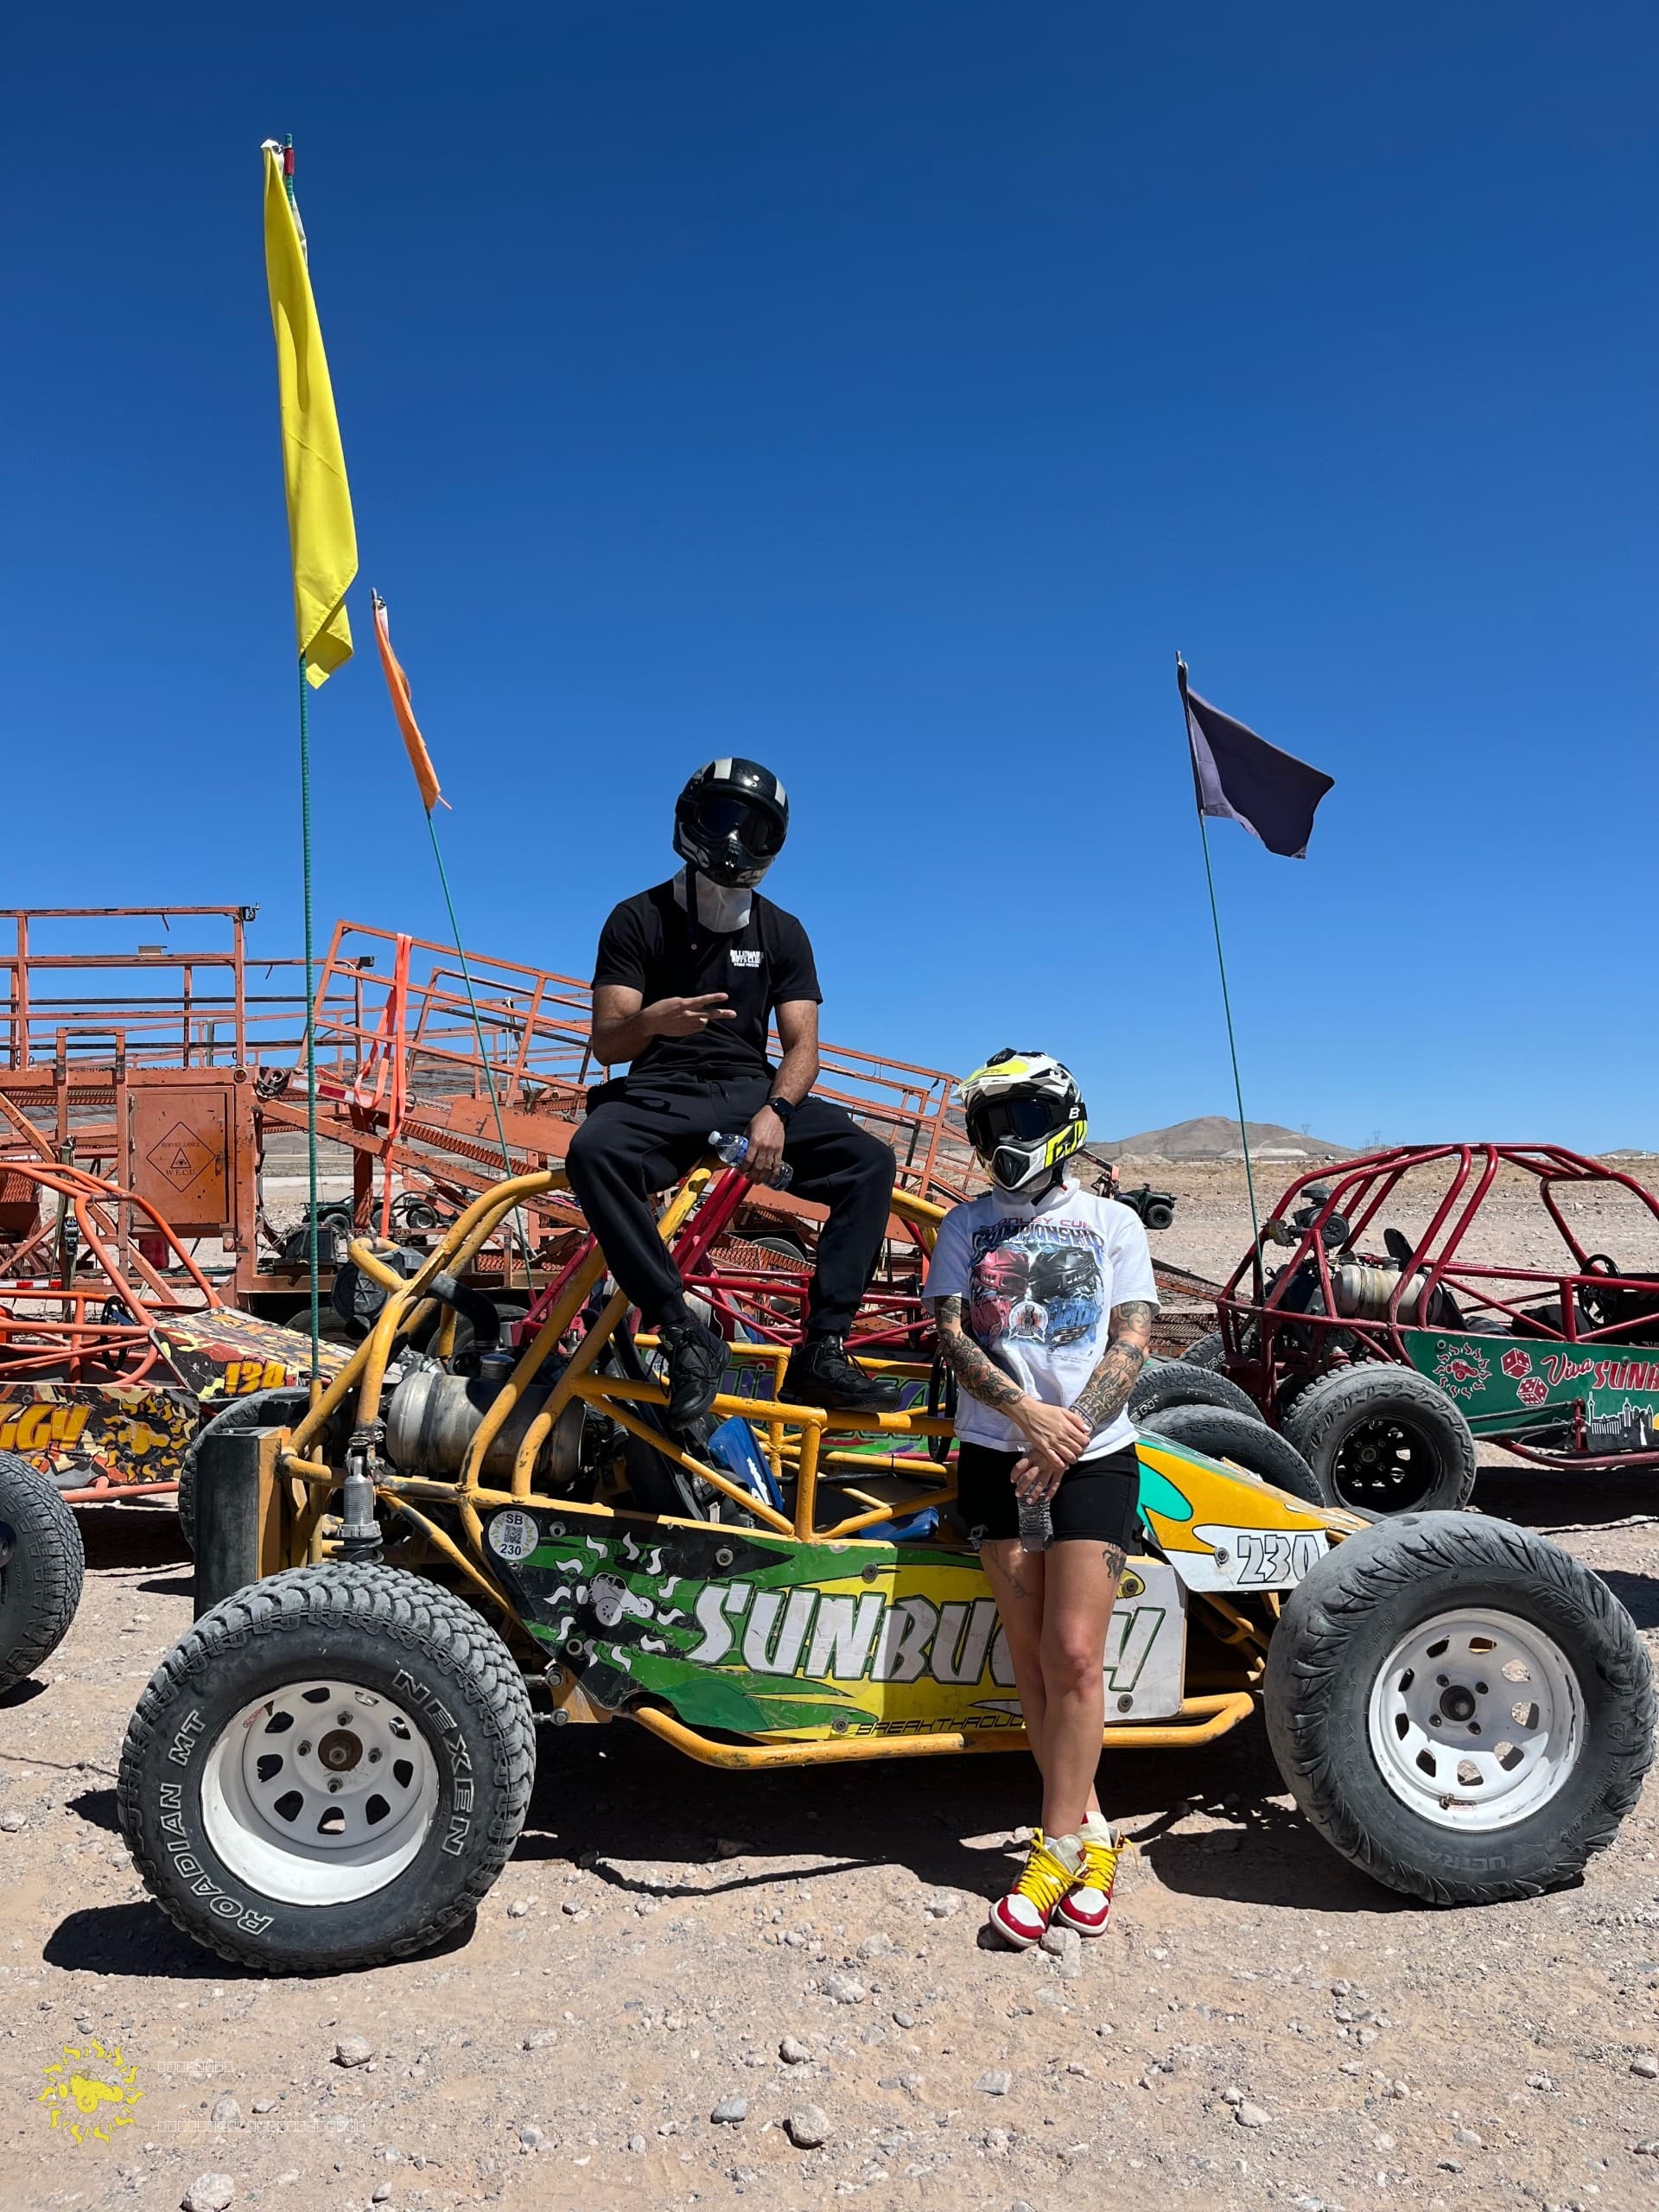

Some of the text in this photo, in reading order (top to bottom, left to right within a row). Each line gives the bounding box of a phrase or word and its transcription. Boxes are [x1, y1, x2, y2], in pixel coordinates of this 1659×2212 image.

[505, 1513, 524, 1525] SB
[499, 1543, 522, 1556] 230
[1236, 1534, 1320, 1585] 230
[393, 1669, 474, 1856] NEXEN
[159, 1708, 274, 1936] ROADIAN MT
